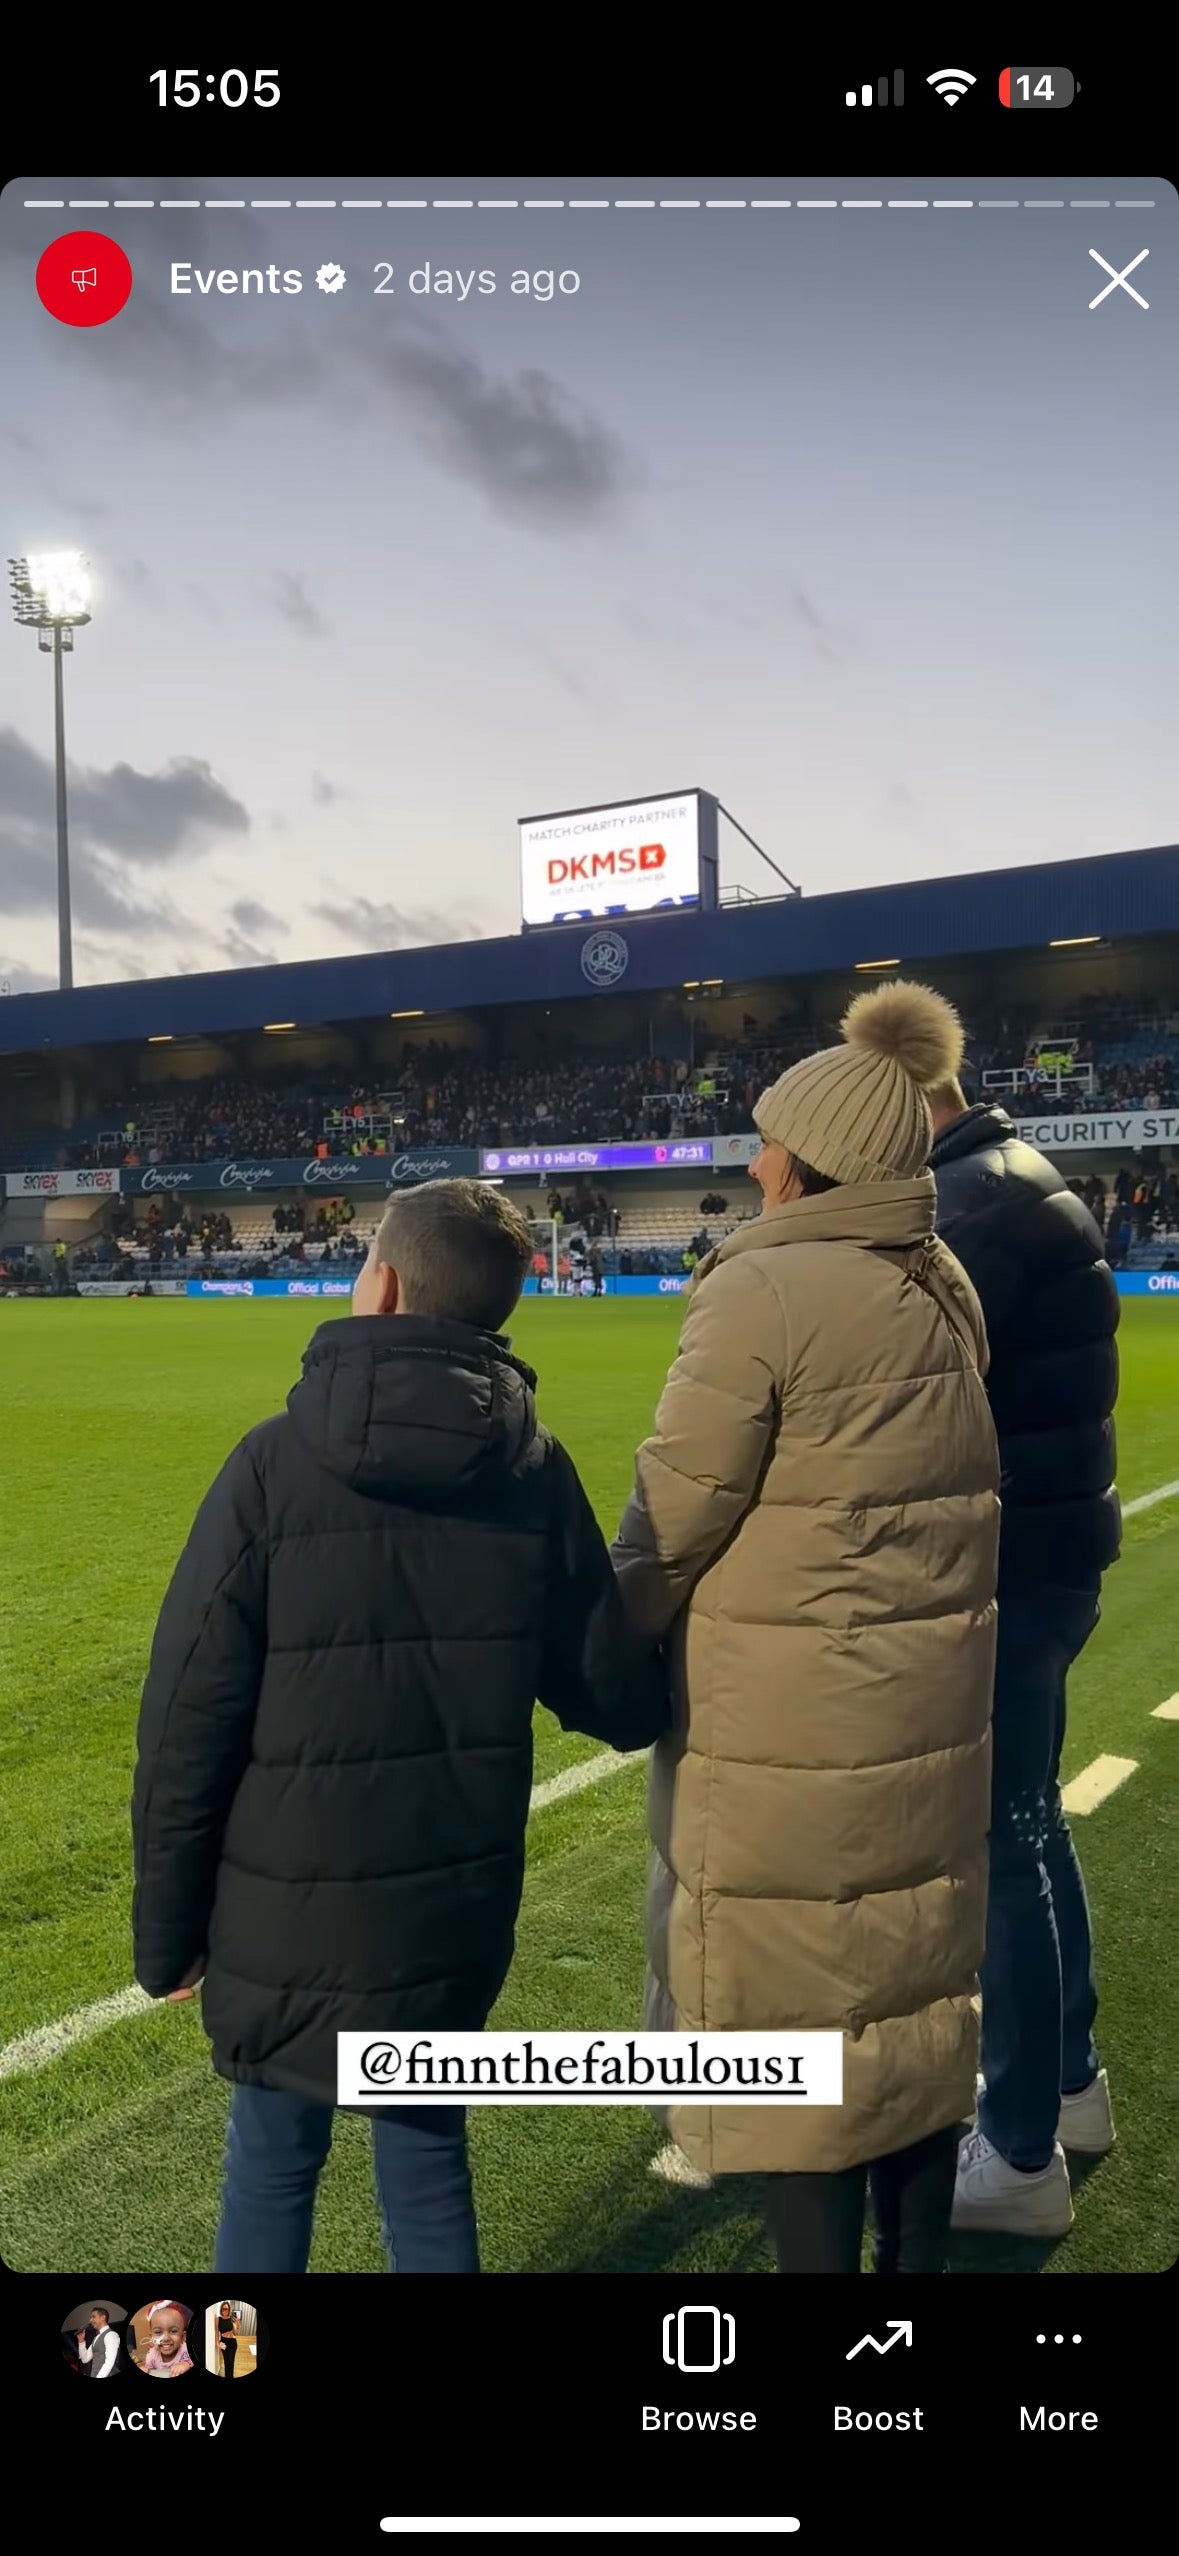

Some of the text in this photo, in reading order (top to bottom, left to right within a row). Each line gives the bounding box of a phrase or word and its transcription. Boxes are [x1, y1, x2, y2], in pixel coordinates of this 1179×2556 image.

[529, 807, 687, 842] MATCH CHARITY PARTNER
[548, 848, 636, 884] DKMS
[1020, 1120, 1132, 1144] ECURITY
[555, 1153, 575, 1164] Hull
[577, 1151, 598, 1165] City
[288, 1282, 350, 1294] Official Global
